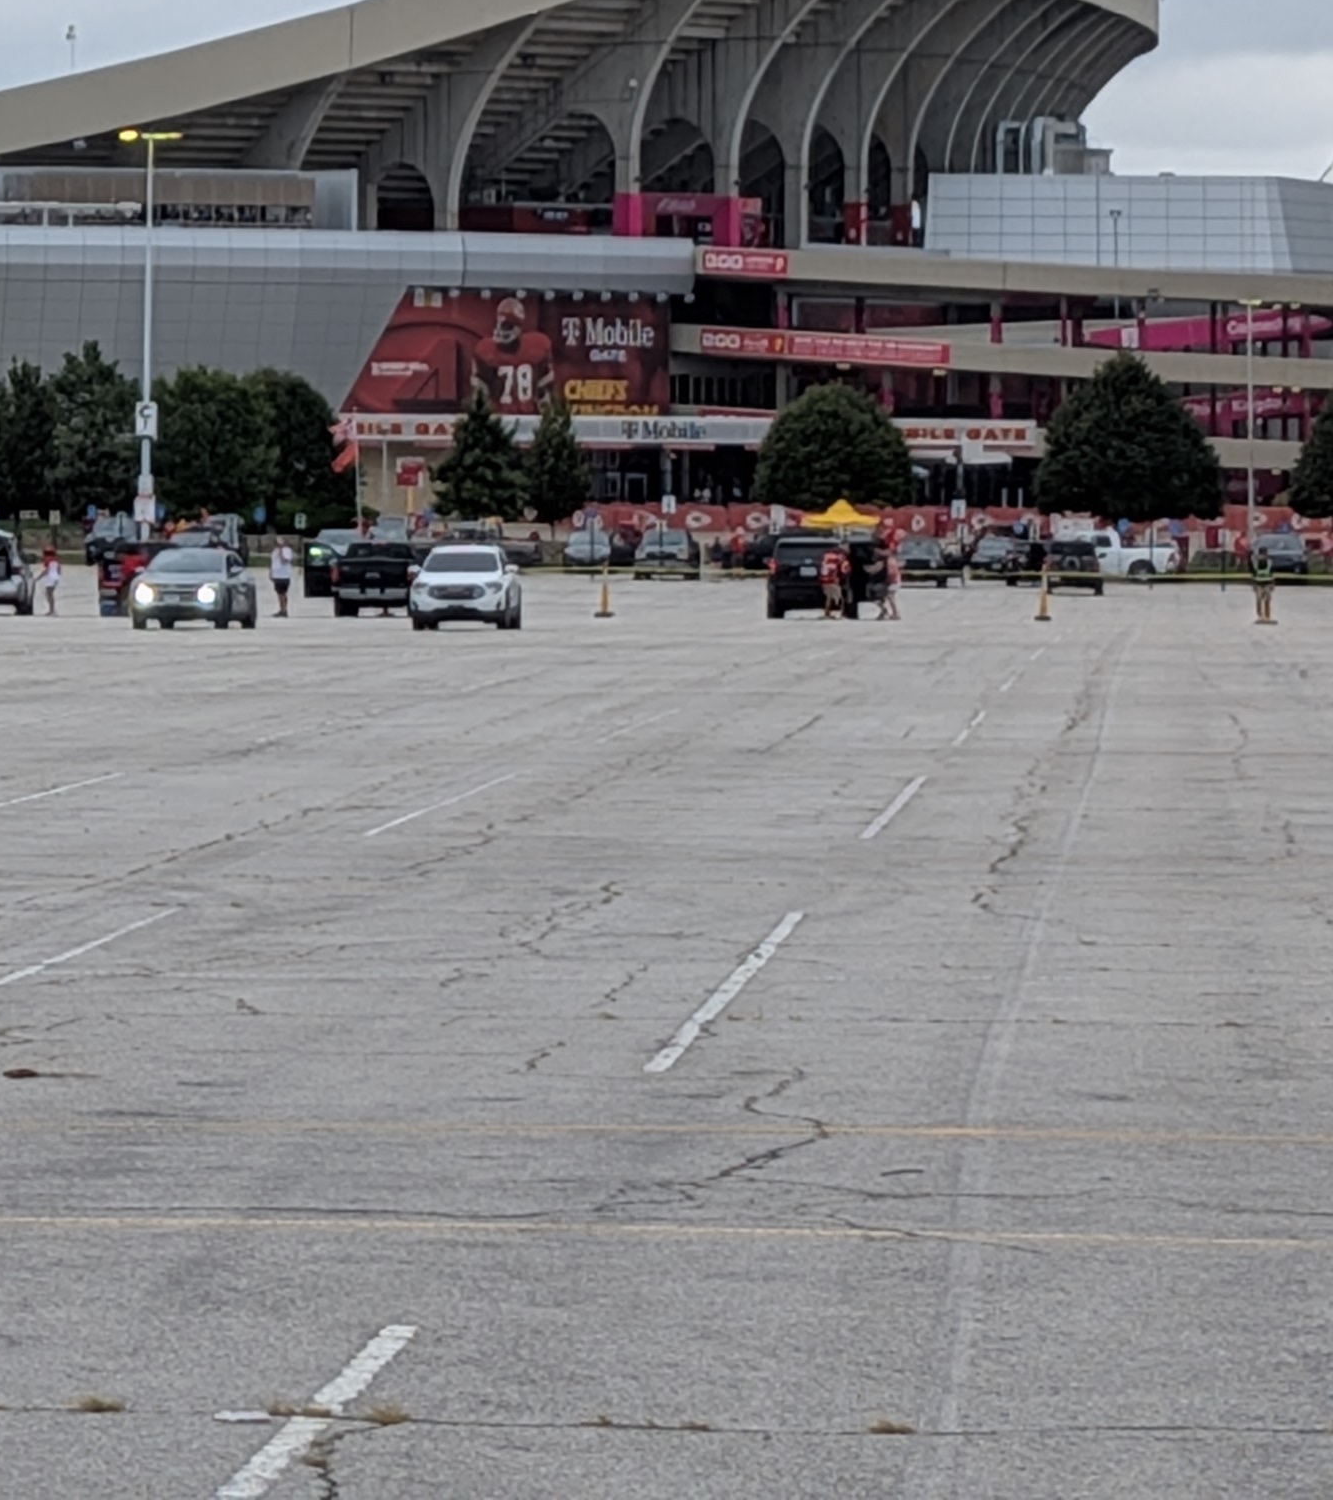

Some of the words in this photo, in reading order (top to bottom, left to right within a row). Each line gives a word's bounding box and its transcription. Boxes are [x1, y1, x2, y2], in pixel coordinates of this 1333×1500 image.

[585, 317, 655, 347] Mobile
[564, 379, 629, 400] CHIEFS
[139, 404, 153, 419] C
[642, 420, 707, 439] Mobile
[965, 428, 1024, 440] GATE
